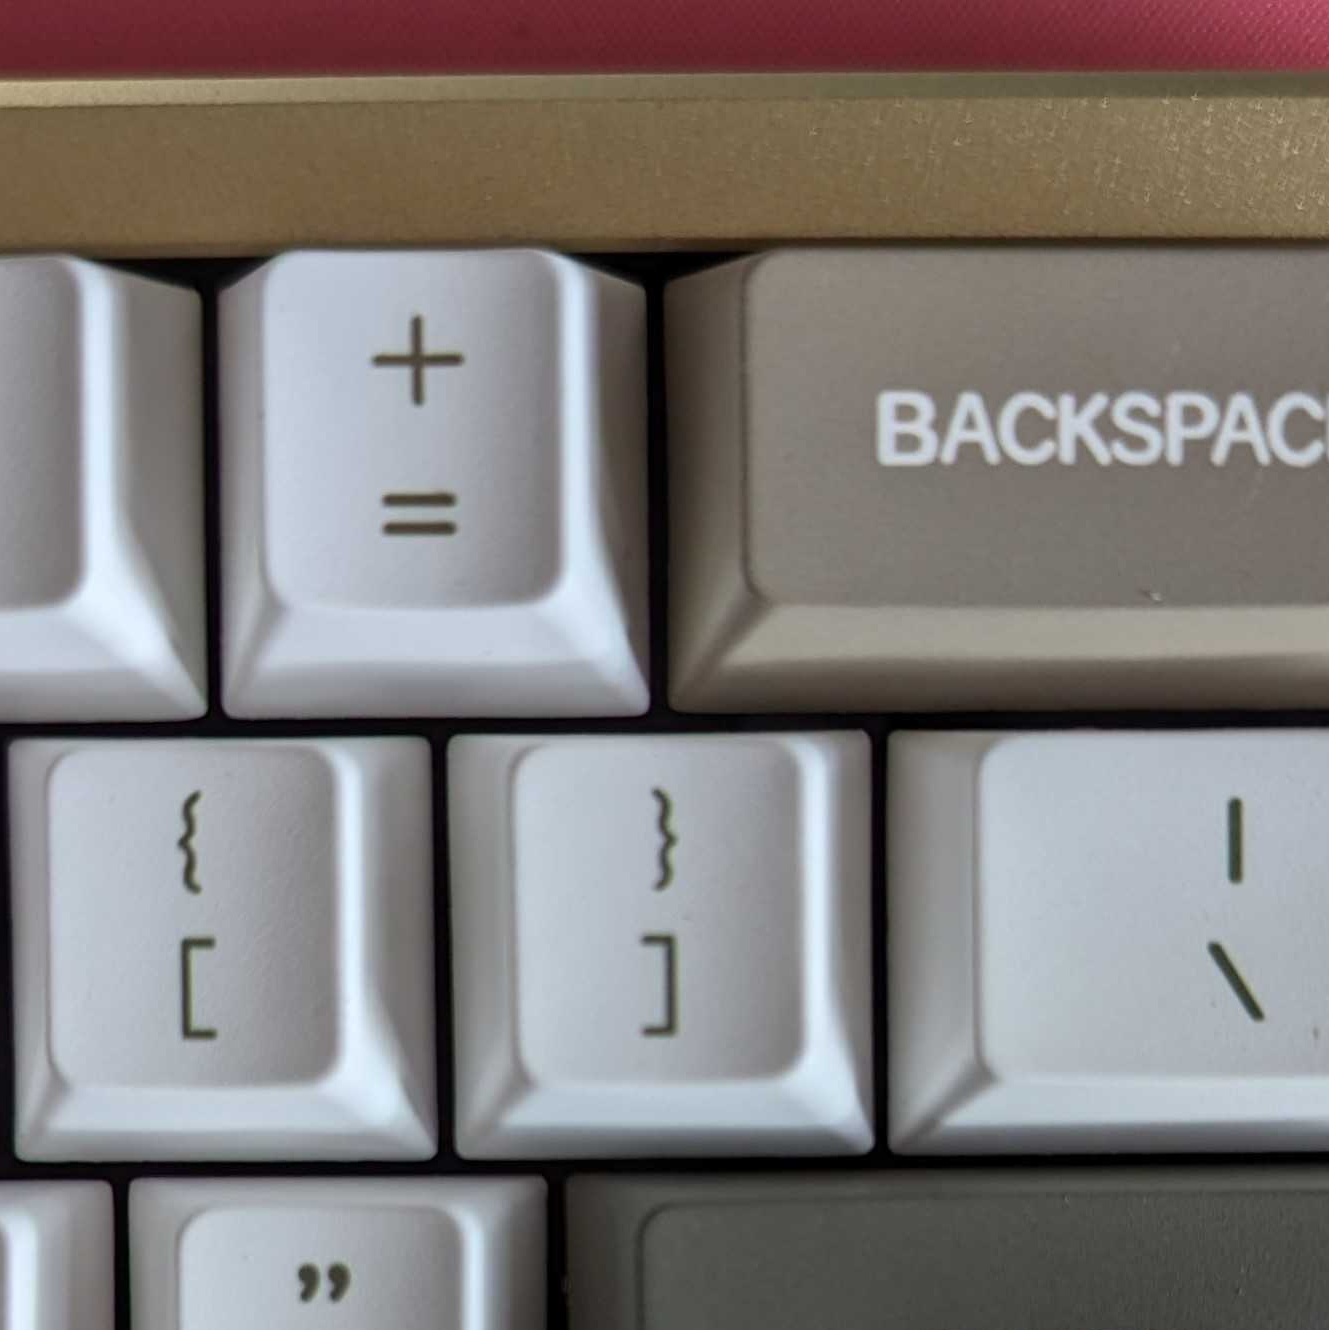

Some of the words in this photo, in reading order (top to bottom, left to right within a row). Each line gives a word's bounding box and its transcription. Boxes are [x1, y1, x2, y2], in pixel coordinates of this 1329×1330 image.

[371, 314, 466, 407] +
[382, 491, 458, 537] =
[176, 790, 202, 895] {
[651, 787, 678, 892] }
[179, 936, 218, 1041] [
[640, 933, 678, 1038] ]
[1206, 940, 1266, 1023] \
